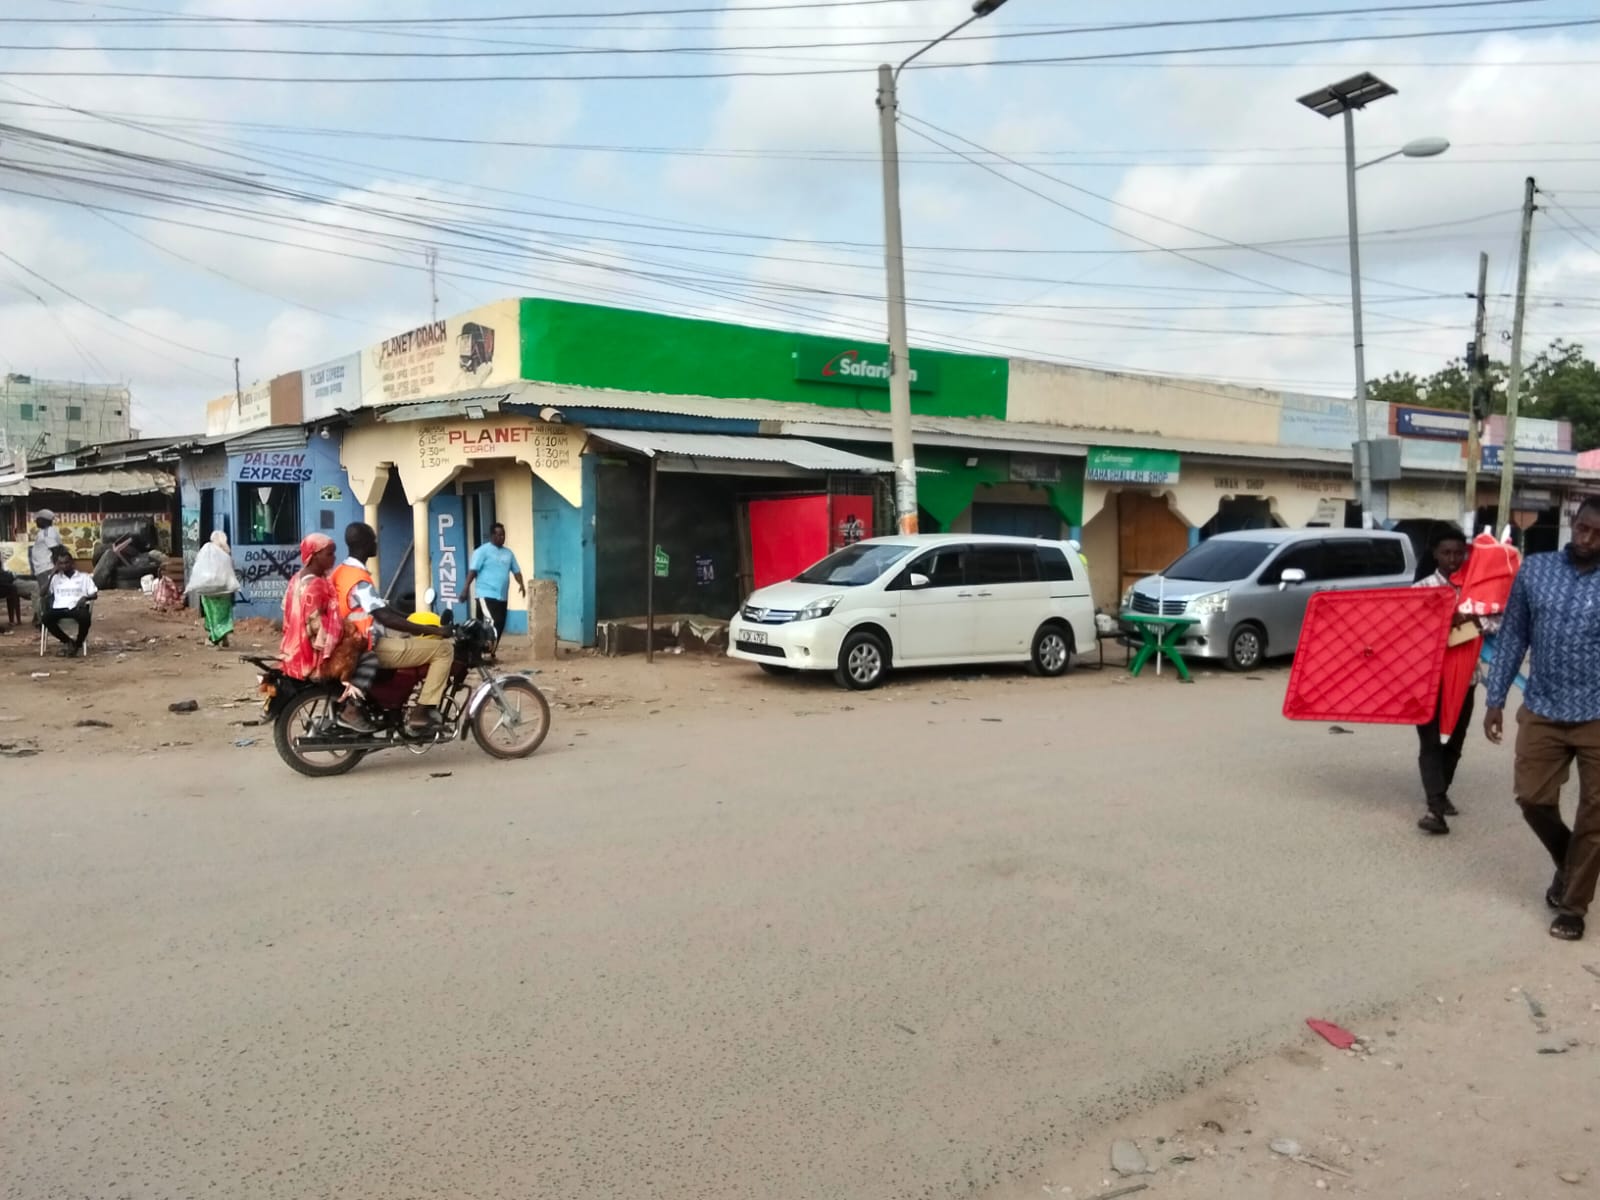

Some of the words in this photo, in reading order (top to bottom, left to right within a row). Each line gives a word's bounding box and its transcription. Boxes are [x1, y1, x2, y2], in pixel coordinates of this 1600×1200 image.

[381, 330, 414, 358] PLANET
[415, 320, 447, 348] COACH
[839, 357, 918, 382] Safarim
[448, 427, 533, 445] PLANET
[463, 444, 496, 454] COACH
[243, 452, 306, 467] DALSAN
[239, 466, 313, 482] EXPRESS
[244, 550, 302, 562] BOOKING
[438, 513, 459, 610] PLANET
[249, 580, 289, 590] GARISS
